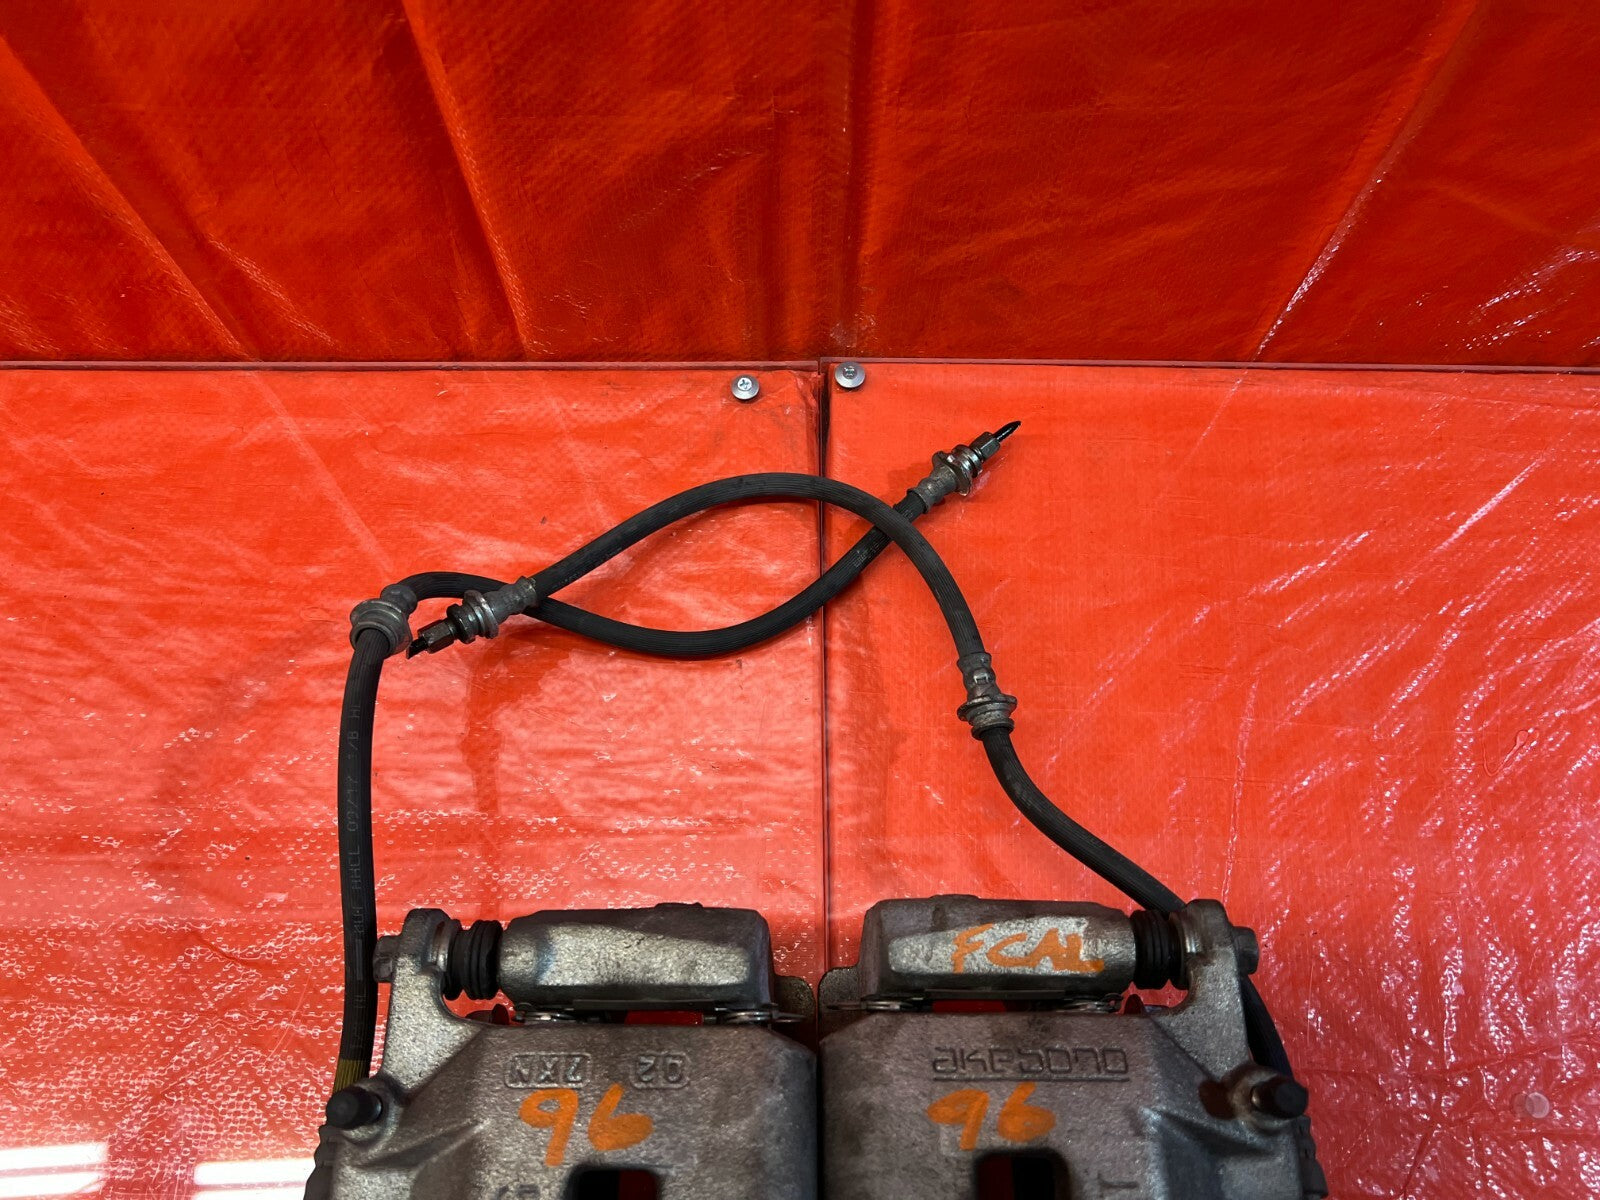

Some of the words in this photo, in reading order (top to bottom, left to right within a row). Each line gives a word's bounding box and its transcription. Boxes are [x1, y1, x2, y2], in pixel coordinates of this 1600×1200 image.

[951, 923, 1104, 974] FCAL
[932, 1048, 1129, 1074] akebono
[518, 1083, 655, 1167] 96
[926, 1081, 1057, 1150] 96
